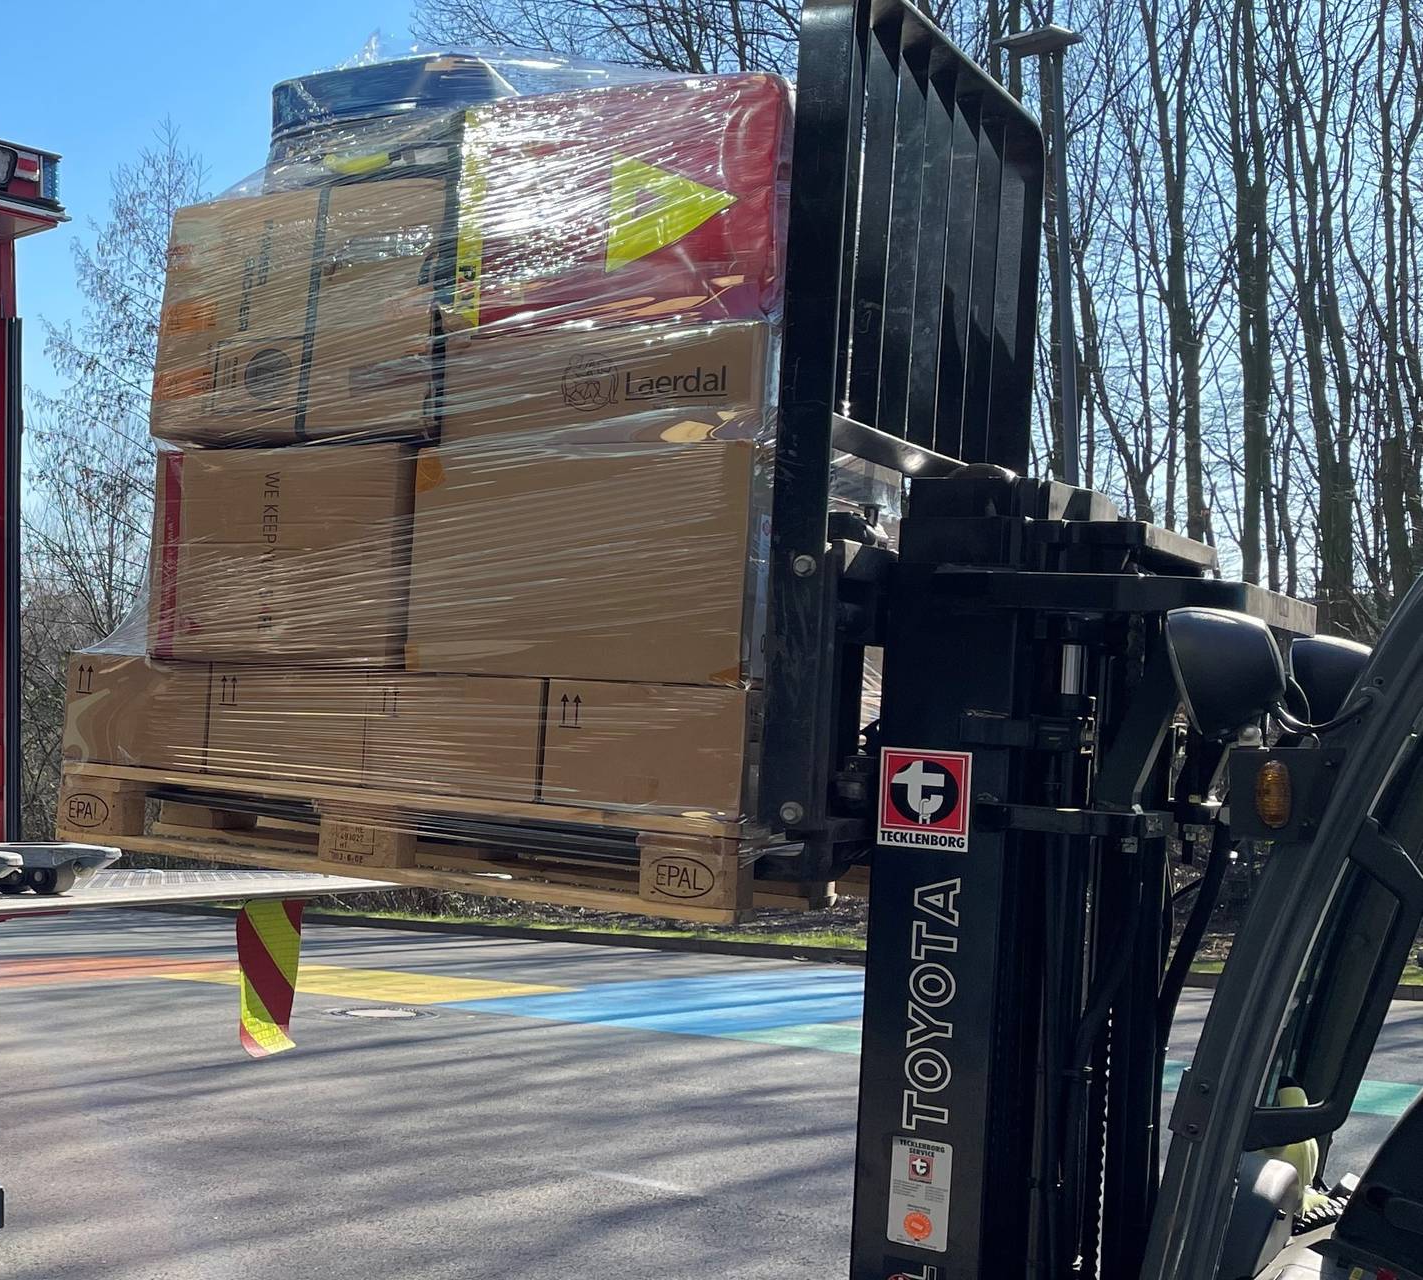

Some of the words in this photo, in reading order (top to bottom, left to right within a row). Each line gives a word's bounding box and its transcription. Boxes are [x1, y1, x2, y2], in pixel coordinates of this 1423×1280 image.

[626, 365, 727, 396] Laerdal
[264, 471, 280, 498] WE
[262, 504, 278, 544] KEEP
[69, 800, 100, 820] EPAL
[880, 831, 965, 848] TECKLENBORG
[656, 864, 705, 890] EPAL
[902, 877, 962, 1131] TOYOTA
[899, 1139, 945, 1154] TECKLENBORG
[909, 1147, 935, 1158] SERVICE
